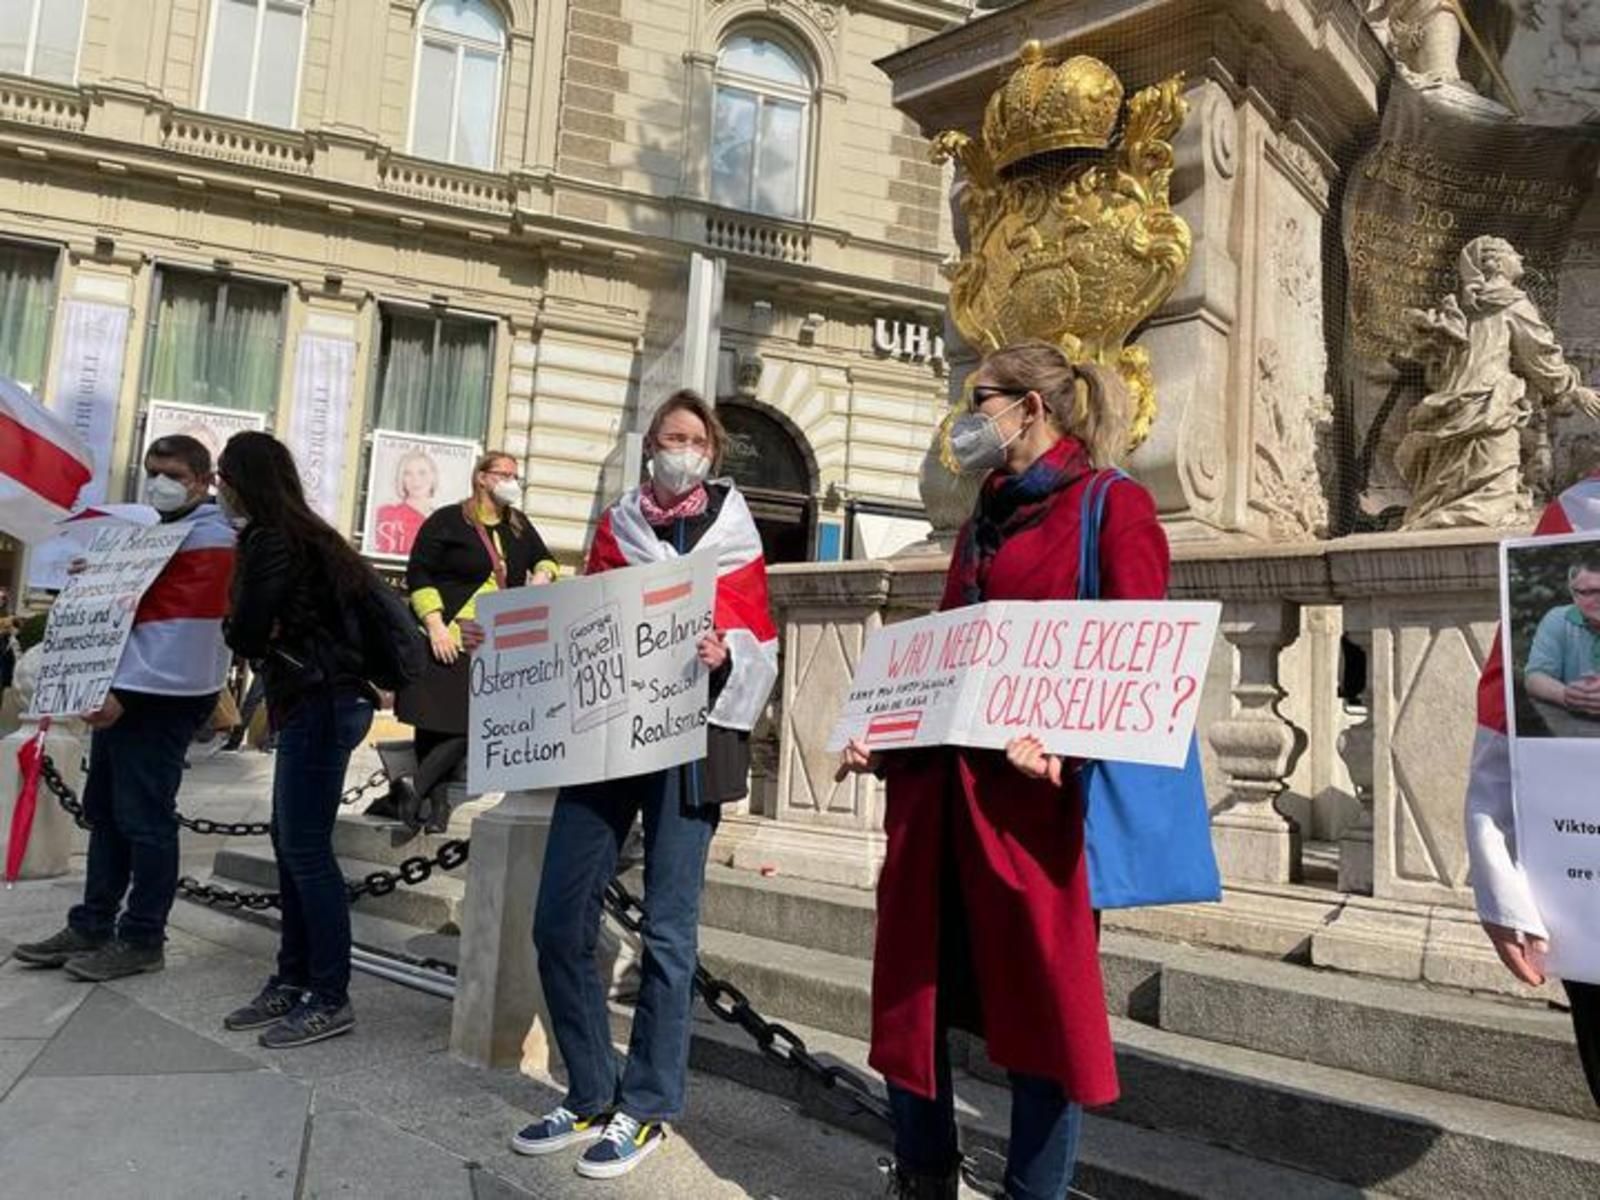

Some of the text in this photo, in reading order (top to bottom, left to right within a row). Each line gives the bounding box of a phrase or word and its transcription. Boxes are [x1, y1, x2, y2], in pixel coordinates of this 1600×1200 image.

[88, 604, 110, 624] und
[571, 614, 613, 641] George
[569, 623, 621, 668] Orwell
[637, 610, 714, 658] Belarus
[887, 619, 1202, 678] WHO NEEDS US EXCEPT
[34, 679, 73, 714] KEIN
[573, 653, 627, 709] 1984
[649, 669, 699, 703] Social
[985, 674, 1160, 732] OURSELVES
[482, 707, 536, 740] Social
[631, 706, 709, 749] Realismus
[486, 738, 566, 770] Fiction
[1567, 868, 1594, 881] are
